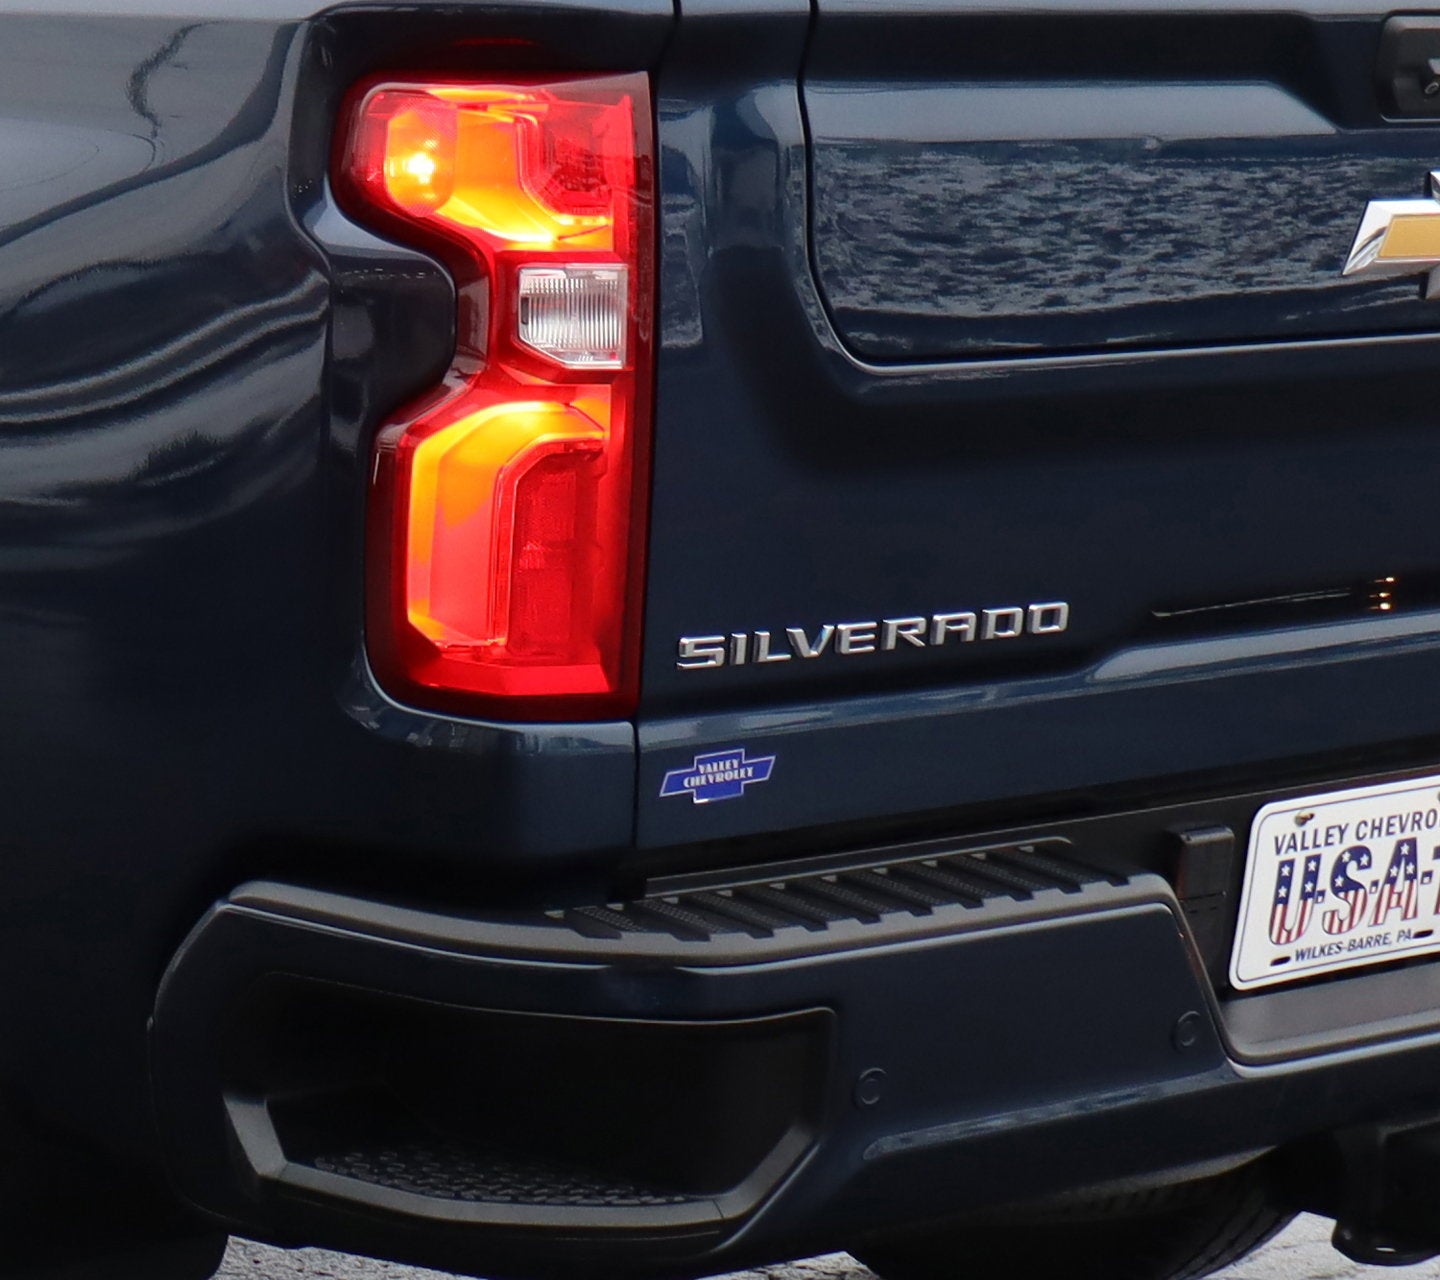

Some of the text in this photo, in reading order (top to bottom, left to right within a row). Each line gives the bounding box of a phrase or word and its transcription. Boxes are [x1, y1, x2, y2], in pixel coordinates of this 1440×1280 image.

[676, 601, 1069, 671] SILVERADO
[683, 766, 754, 788] CHEVROLET
[698, 758, 740, 774] VALLEY
[1273, 823, 1350, 856] VALLEY
[1294, 932, 1392, 962] WILKES-BARRE,
